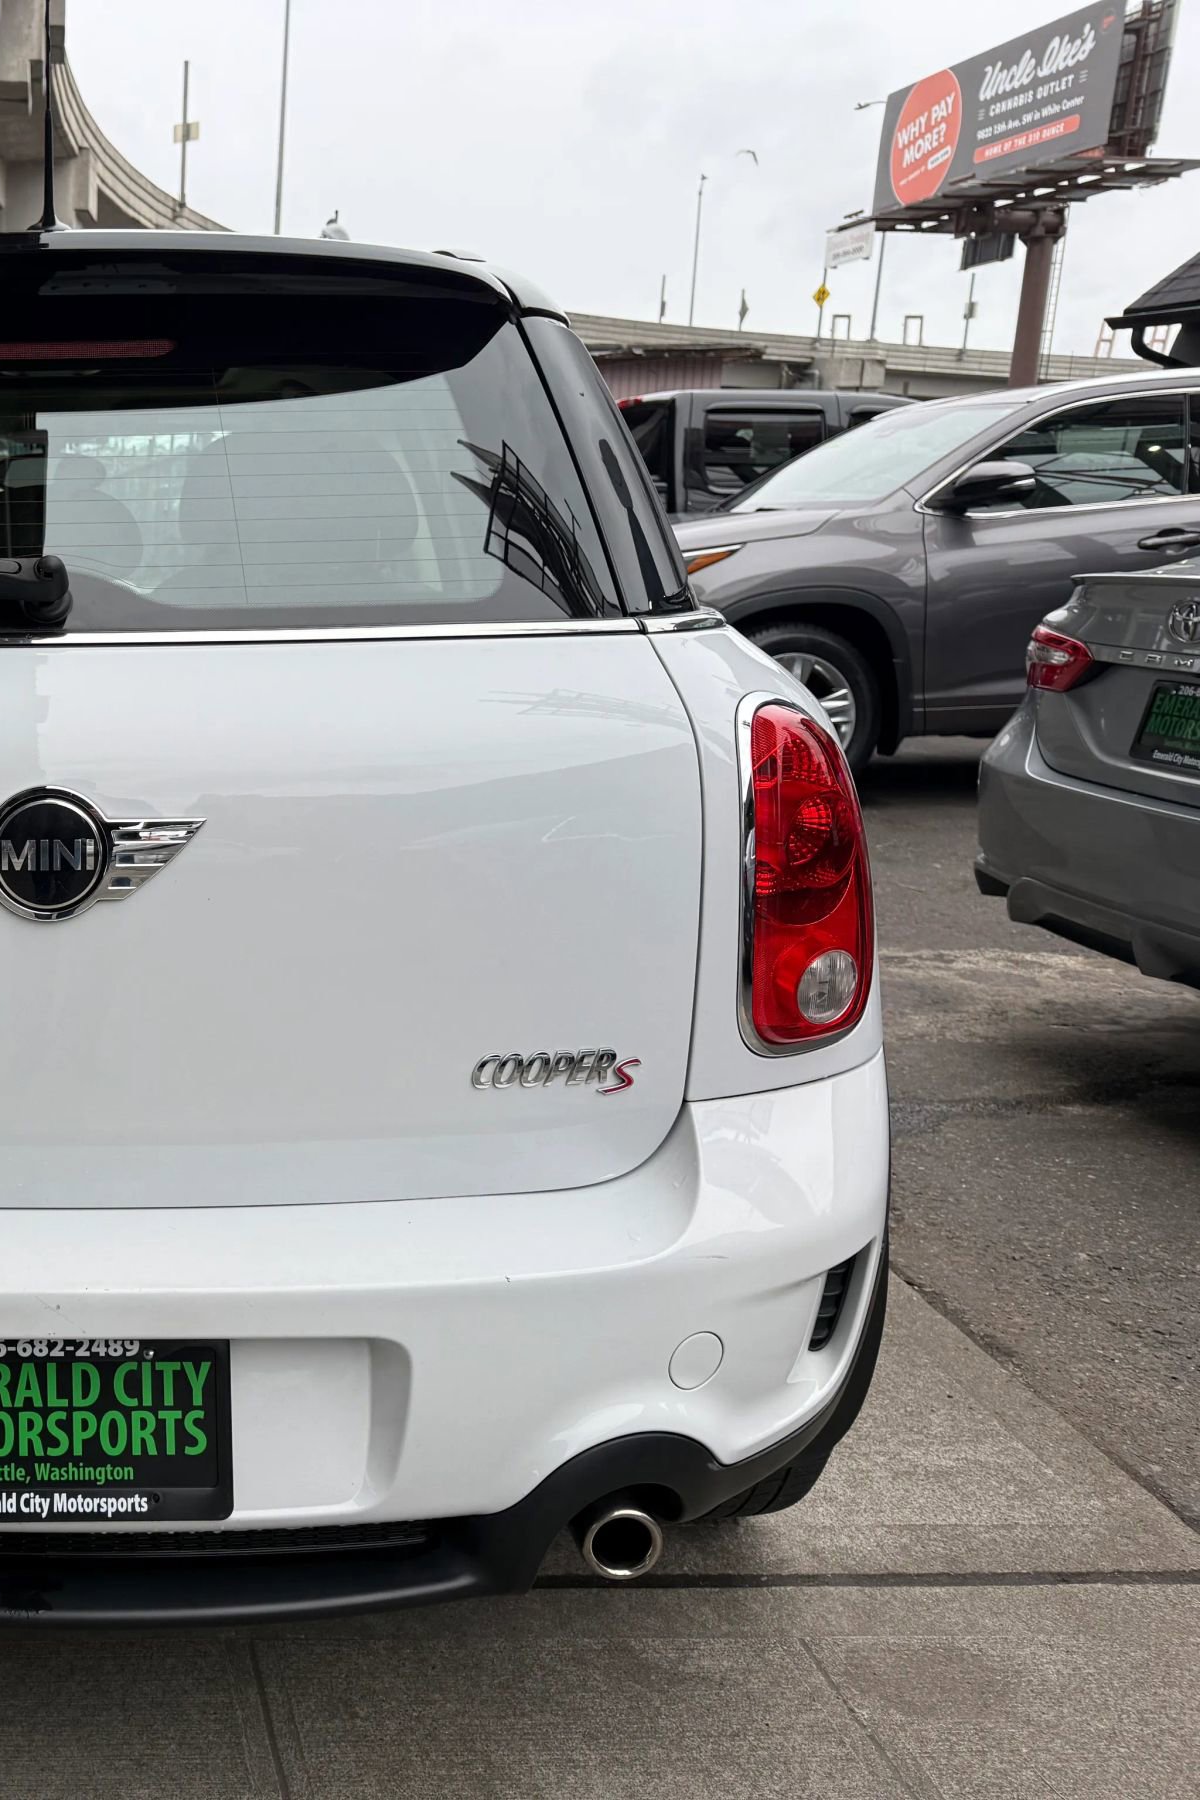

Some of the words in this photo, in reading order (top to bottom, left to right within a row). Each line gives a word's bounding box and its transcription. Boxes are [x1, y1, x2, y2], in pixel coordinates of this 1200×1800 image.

[979, 49, 1036, 101] Uncle
[1037, 22, 1097, 77] Ike's
[989, 90, 1034, 117] CANNABIS
[1036, 74, 1075, 99] OUTLET
[1022, 112, 1034, 125] SW
[1034, 109, 1041, 121] in
[1041, 103, 1061, 118] White
[1061, 95, 1085, 111] Center
[897, 112, 928, 149] WHY
[931, 91, 956, 126] PAY
[902, 122, 947, 168] MORE?
[1152, 749, 1174, 762] Emerald
[1173, 753, 1185, 765] City
[1, 838, 95, 871] MINI
[471, 1046, 618, 1090] COOPER
[113, 1361, 212, 1407] CITY
[34, 1462, 135, 1485] Washington
[19, 1493, 50, 1519] City
[53, 1493, 148, 1518] Motorsports
